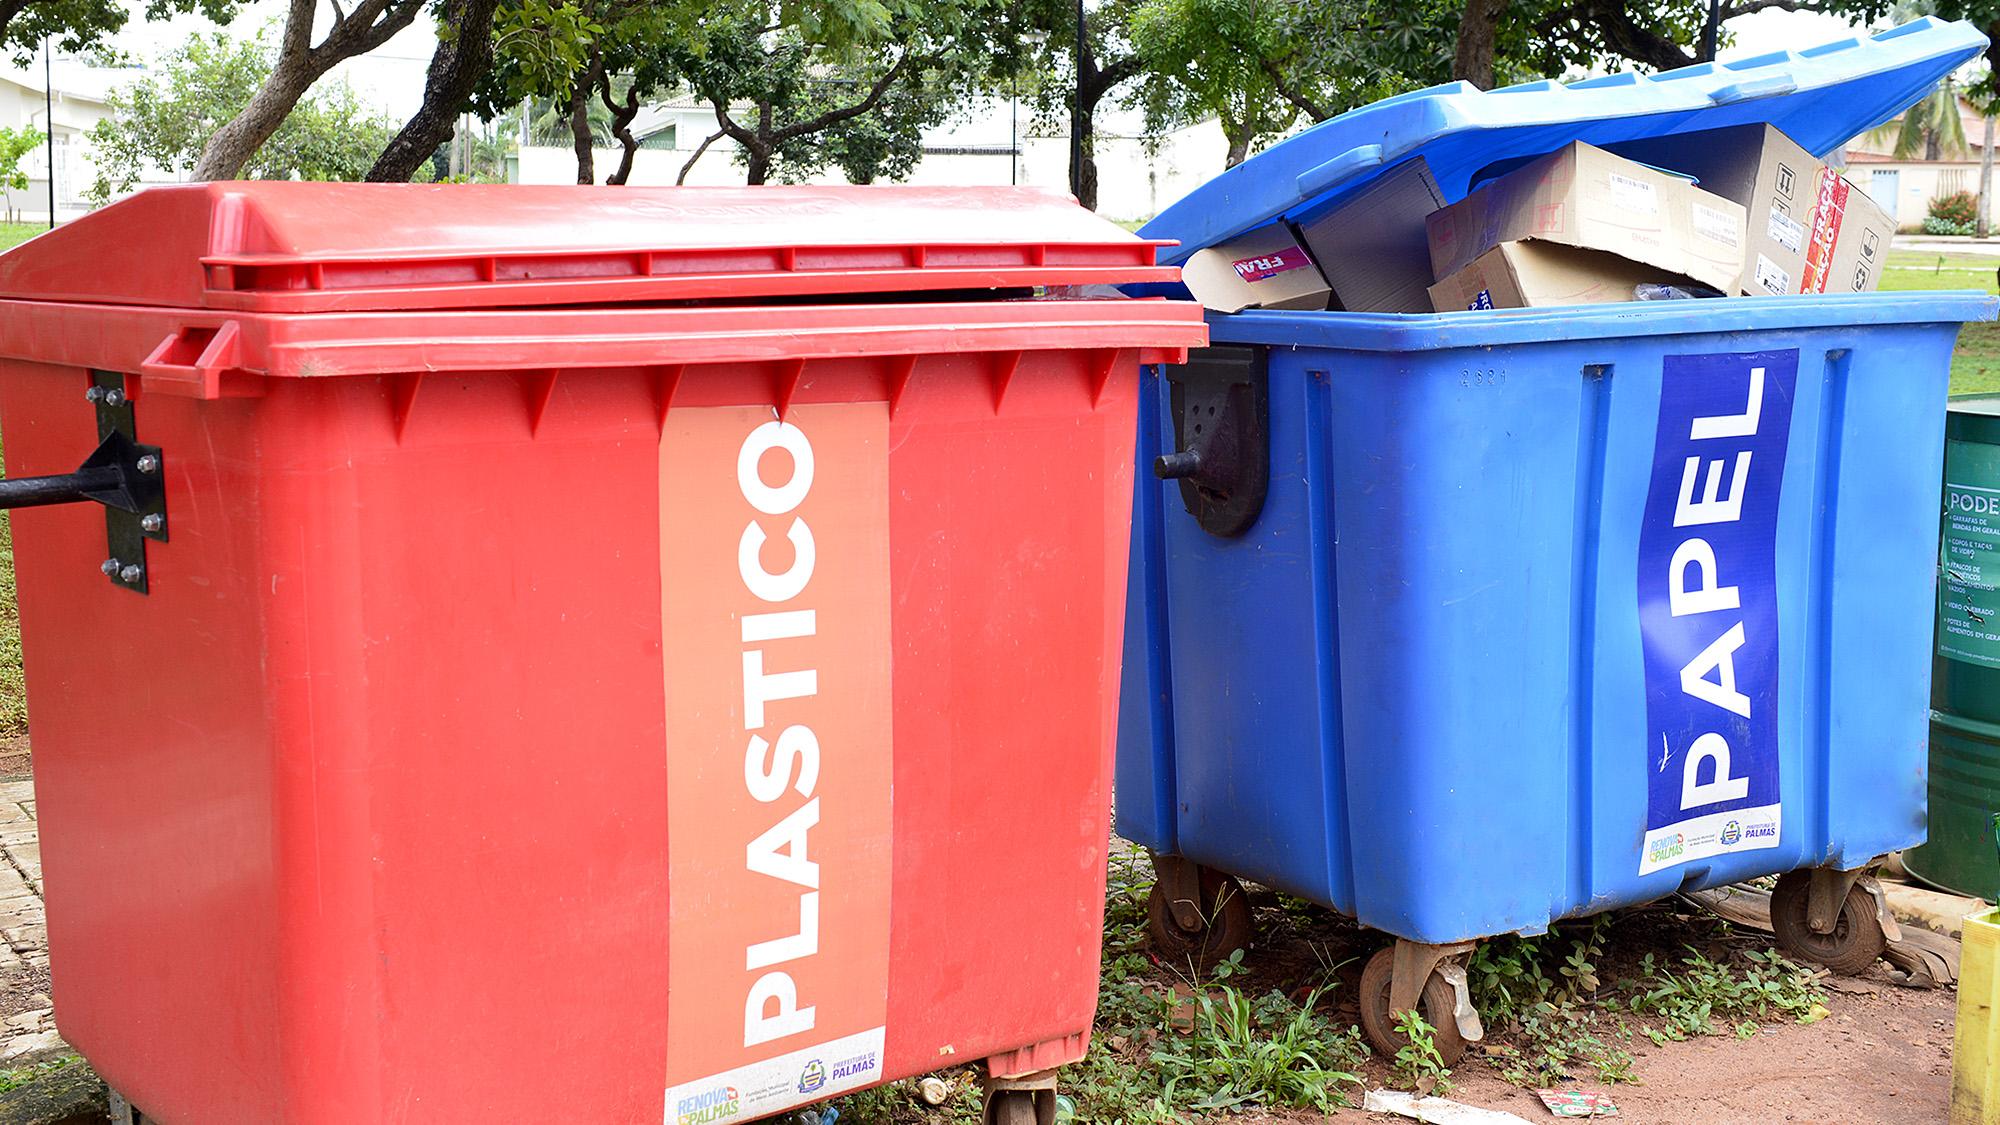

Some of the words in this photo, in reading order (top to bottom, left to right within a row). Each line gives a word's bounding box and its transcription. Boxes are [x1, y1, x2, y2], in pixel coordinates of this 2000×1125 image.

[1951, 492, 1999, 515] PODE
[1668, 367, 1766, 811] PAPEL
[1975, 631, 1984, 639] EM
[737, 420, 820, 1048] PLASTICO
[1650, 833, 1679, 853] RENOVA
[1745, 827, 1776, 838] PALMAS
[1654, 844, 1684, 863] PALMAS
[832, 1058, 876, 1080] PALMAS
[678, 1087, 729, 1116] RENOVA
[688, 1099, 739, 1125] PALMAS
